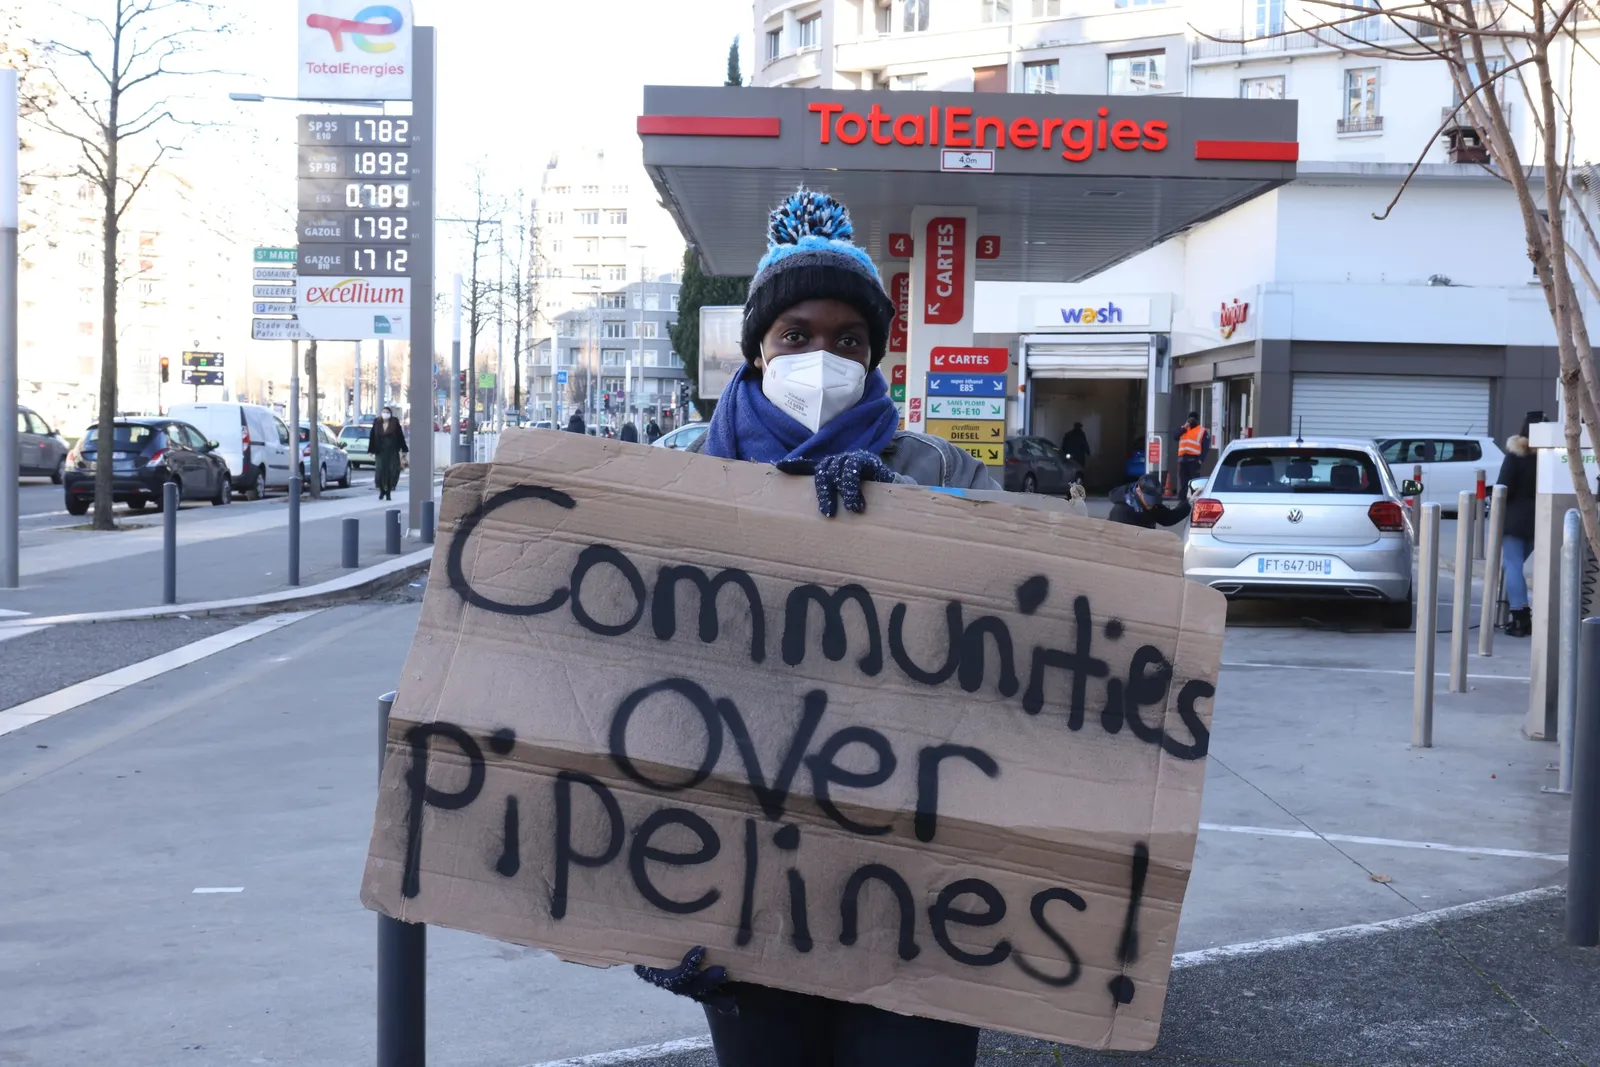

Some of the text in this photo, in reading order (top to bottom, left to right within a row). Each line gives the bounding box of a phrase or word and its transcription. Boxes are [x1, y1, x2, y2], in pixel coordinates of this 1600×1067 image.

[306, 62, 404, 78] TotalEnergies
[308, 121, 338, 132] SP 95
[355, 120, 408, 142] 1.782
[809, 103, 1168, 162] TotalEnergies
[309, 162, 337, 172] SP 98
[355, 152, 408, 175] 1.892
[346, 184, 408, 208] 0.789
[304, 228, 341, 236] GAZOLE
[354, 217, 408, 239] 1.792
[895, 238, 905, 252] 4
[984, 240, 994, 254] 3
[304, 255, 341, 264] GAZOLE
[354, 249, 408, 272] 1.712
[936, 224, 954, 297] CARTES
[256, 270, 290, 278] DOMAINE
[306, 282, 404, 303] excellium
[1061, 302, 1122, 323] wash
[948, 354, 989, 365] CARTES
[959, 384, 974, 392] E85
[951, 432, 979, 440] DIESEL
[1265, 559, 1322, 572] FT-647-DH
[447, 484, 1214, 760] Communities
